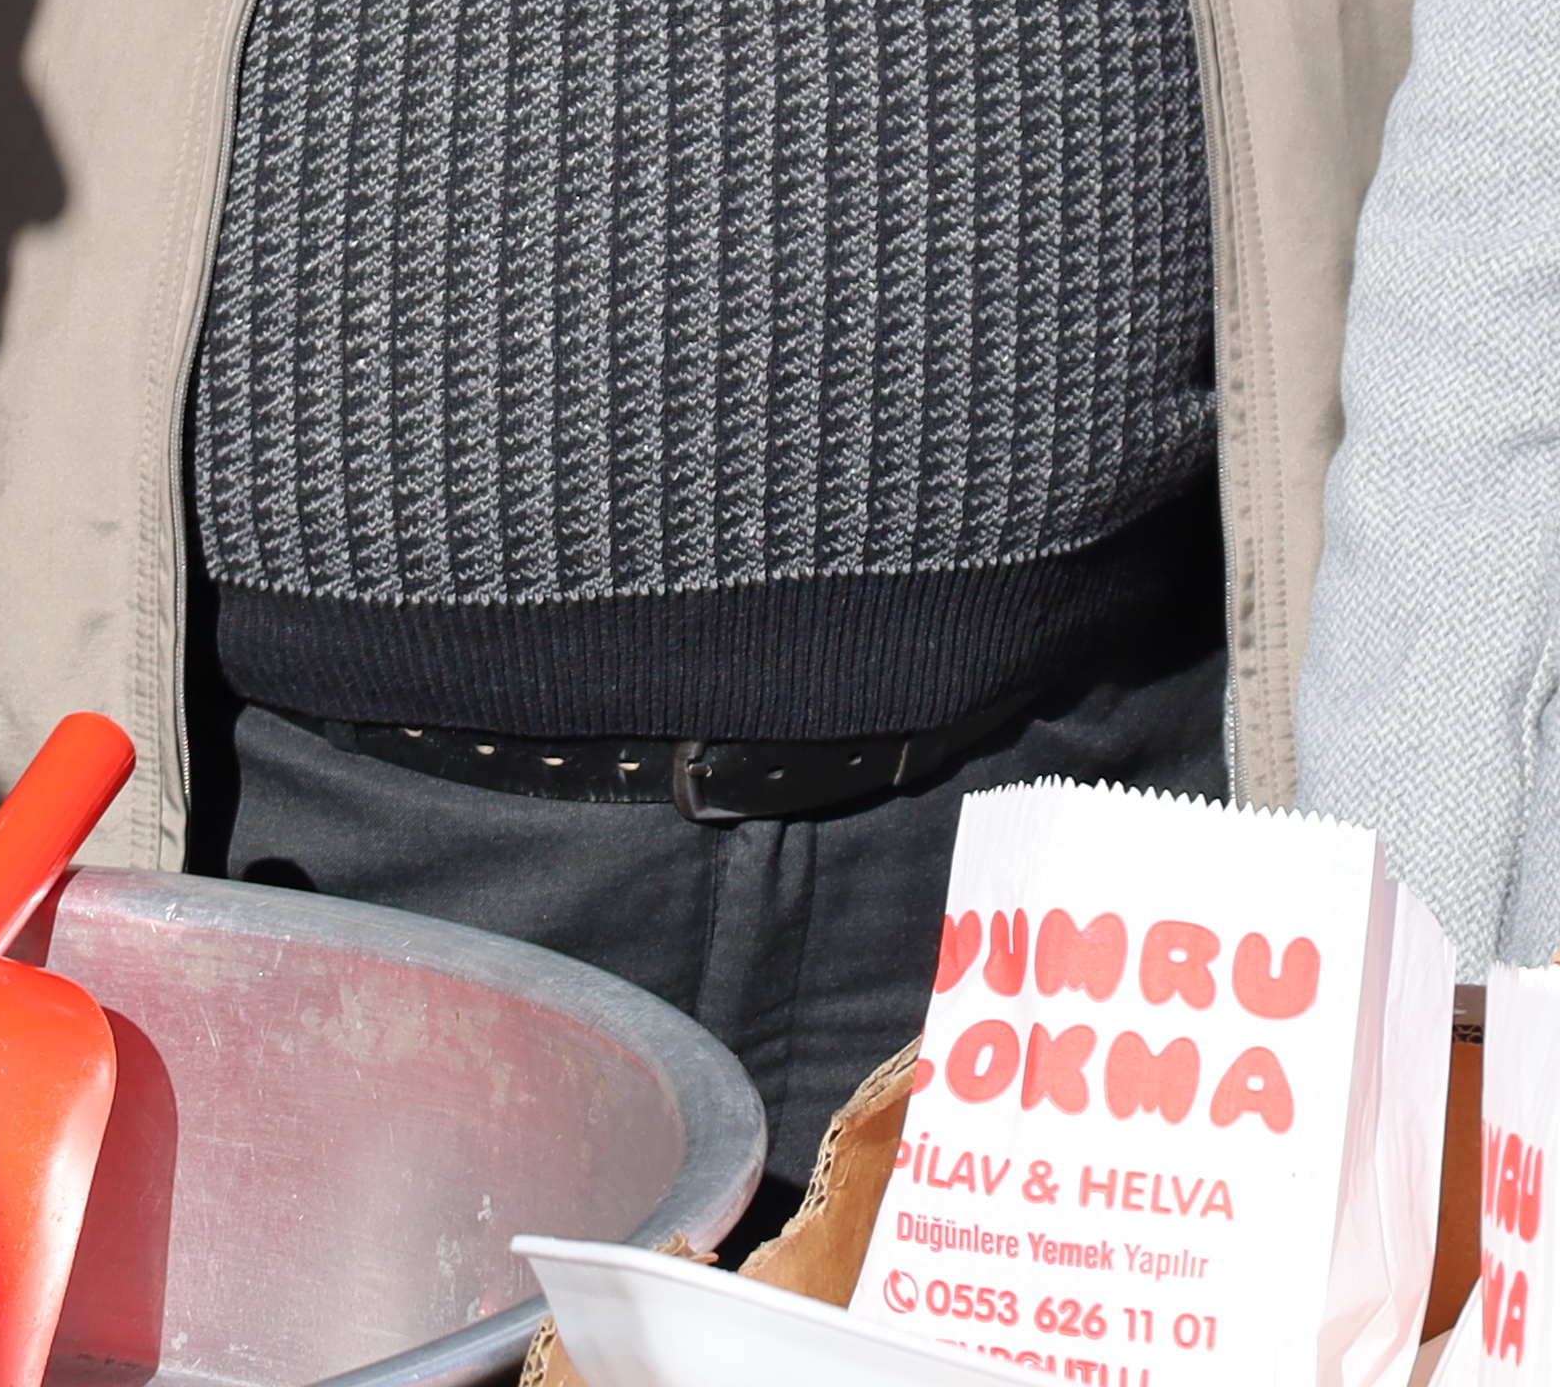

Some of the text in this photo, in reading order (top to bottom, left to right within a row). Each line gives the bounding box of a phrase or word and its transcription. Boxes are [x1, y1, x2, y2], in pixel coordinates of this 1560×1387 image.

[1021, 1159, 1061, 1206] &
[1077, 1164, 1235, 1221] HELVA
[896, 1210, 1210, 1283] Düğünlere Yemek Yapılır
[925, 1279, 1218, 1353] 0553 626 11 01
